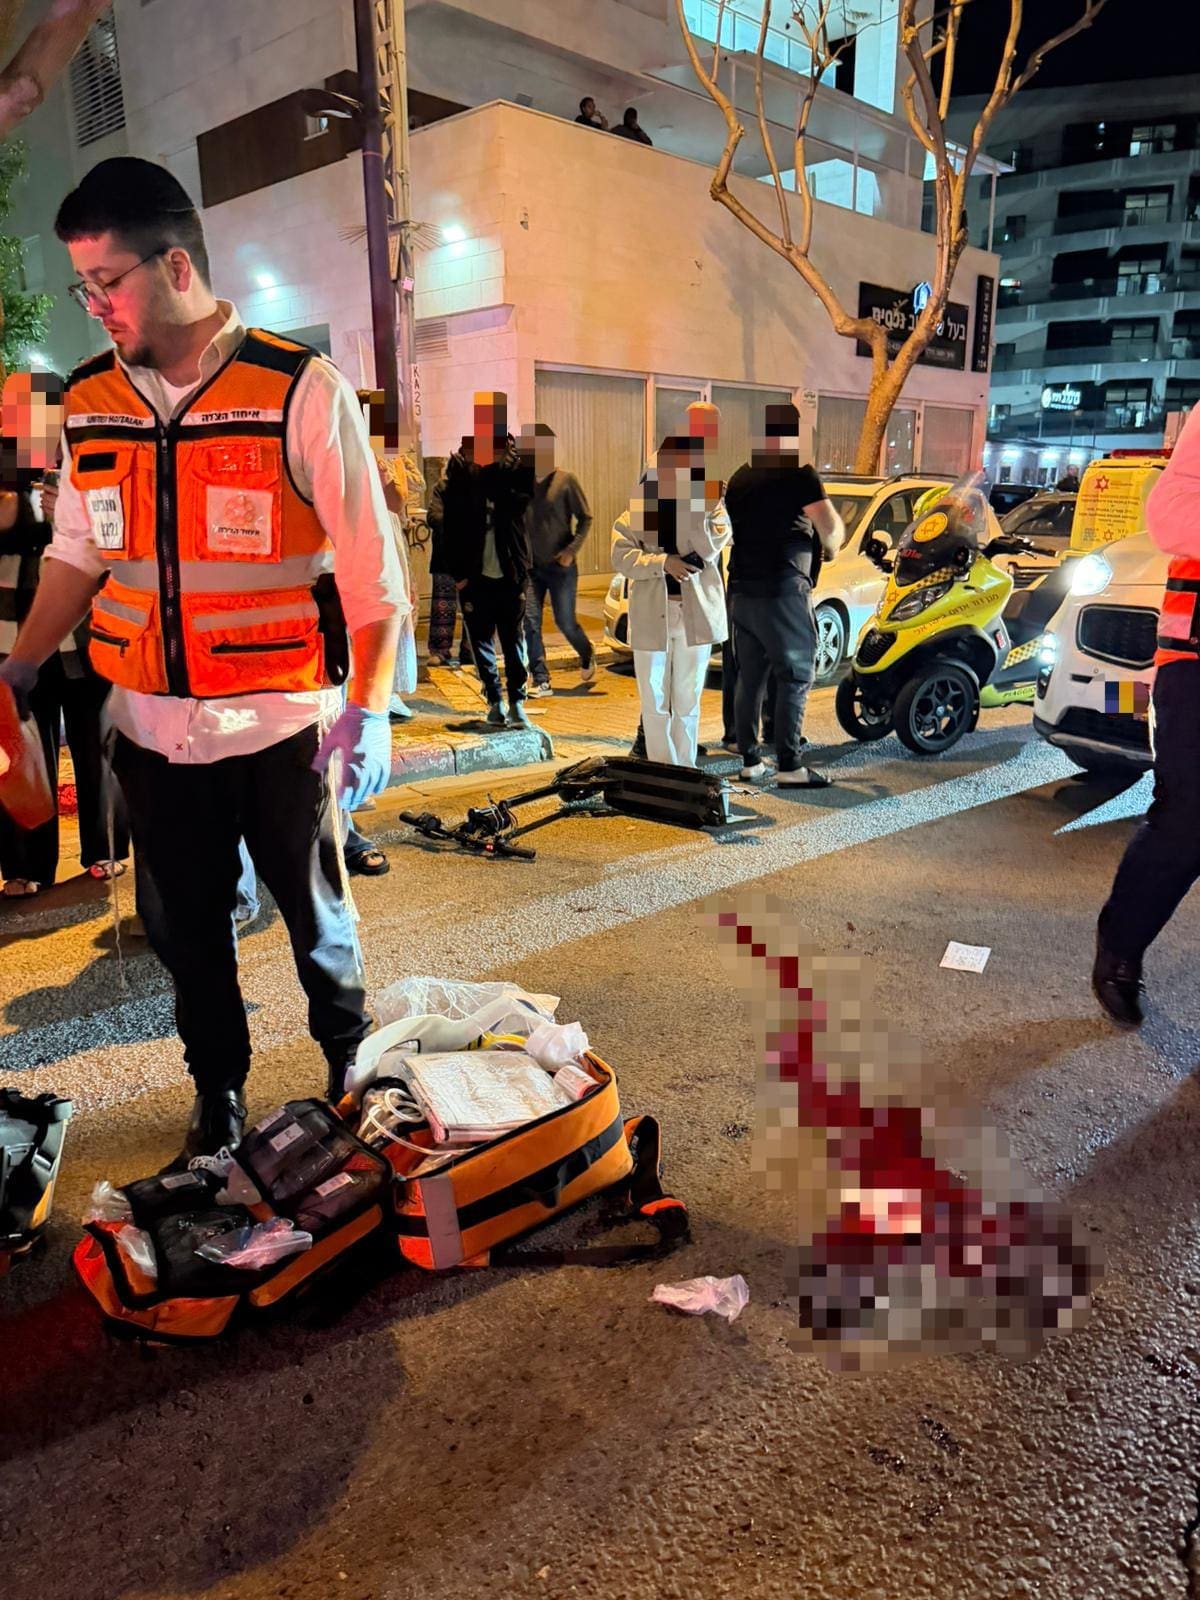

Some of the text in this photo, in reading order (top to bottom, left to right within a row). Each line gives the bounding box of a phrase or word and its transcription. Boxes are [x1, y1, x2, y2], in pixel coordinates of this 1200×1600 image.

[872, 306, 907, 331] נכסים
[947, 317, 966, 341] בעל
[202, 410, 260, 422] איחוד הצלה
[972, 598, 984, 607] דוד
[986, 593, 999, 603] מגן
[948, 604, 970, 616] אדום
